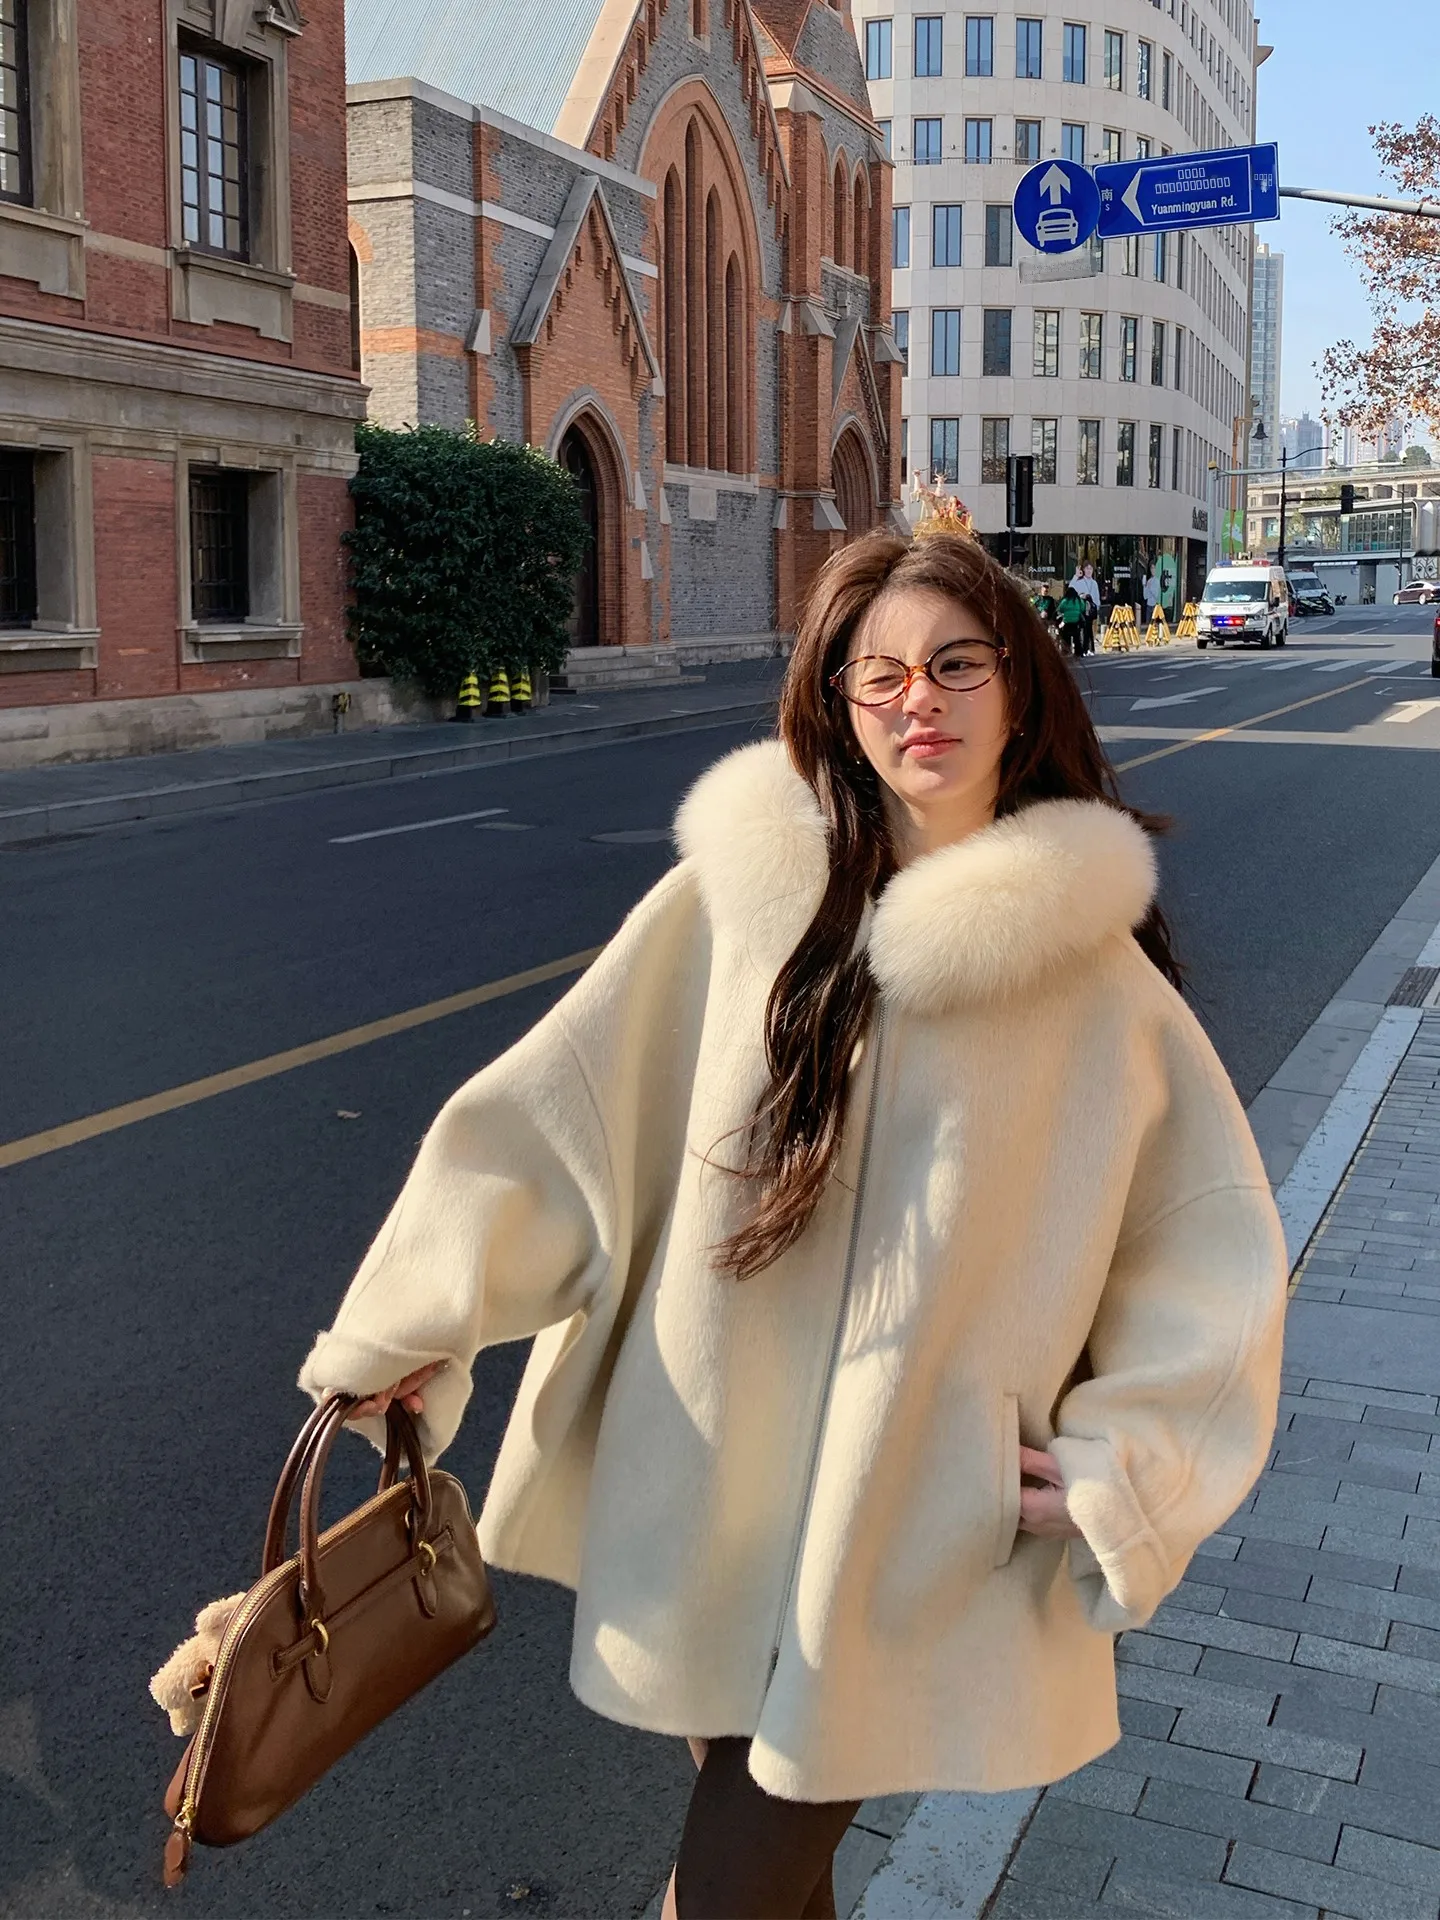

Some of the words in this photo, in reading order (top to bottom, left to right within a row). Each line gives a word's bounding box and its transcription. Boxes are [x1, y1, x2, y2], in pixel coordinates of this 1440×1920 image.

[1101, 188, 1113, 201] 南
[1105, 203, 1110, 211] S
[1151, 199, 1217, 215] Yuanmingyuan
[1221, 195, 1237, 208] Rd.
